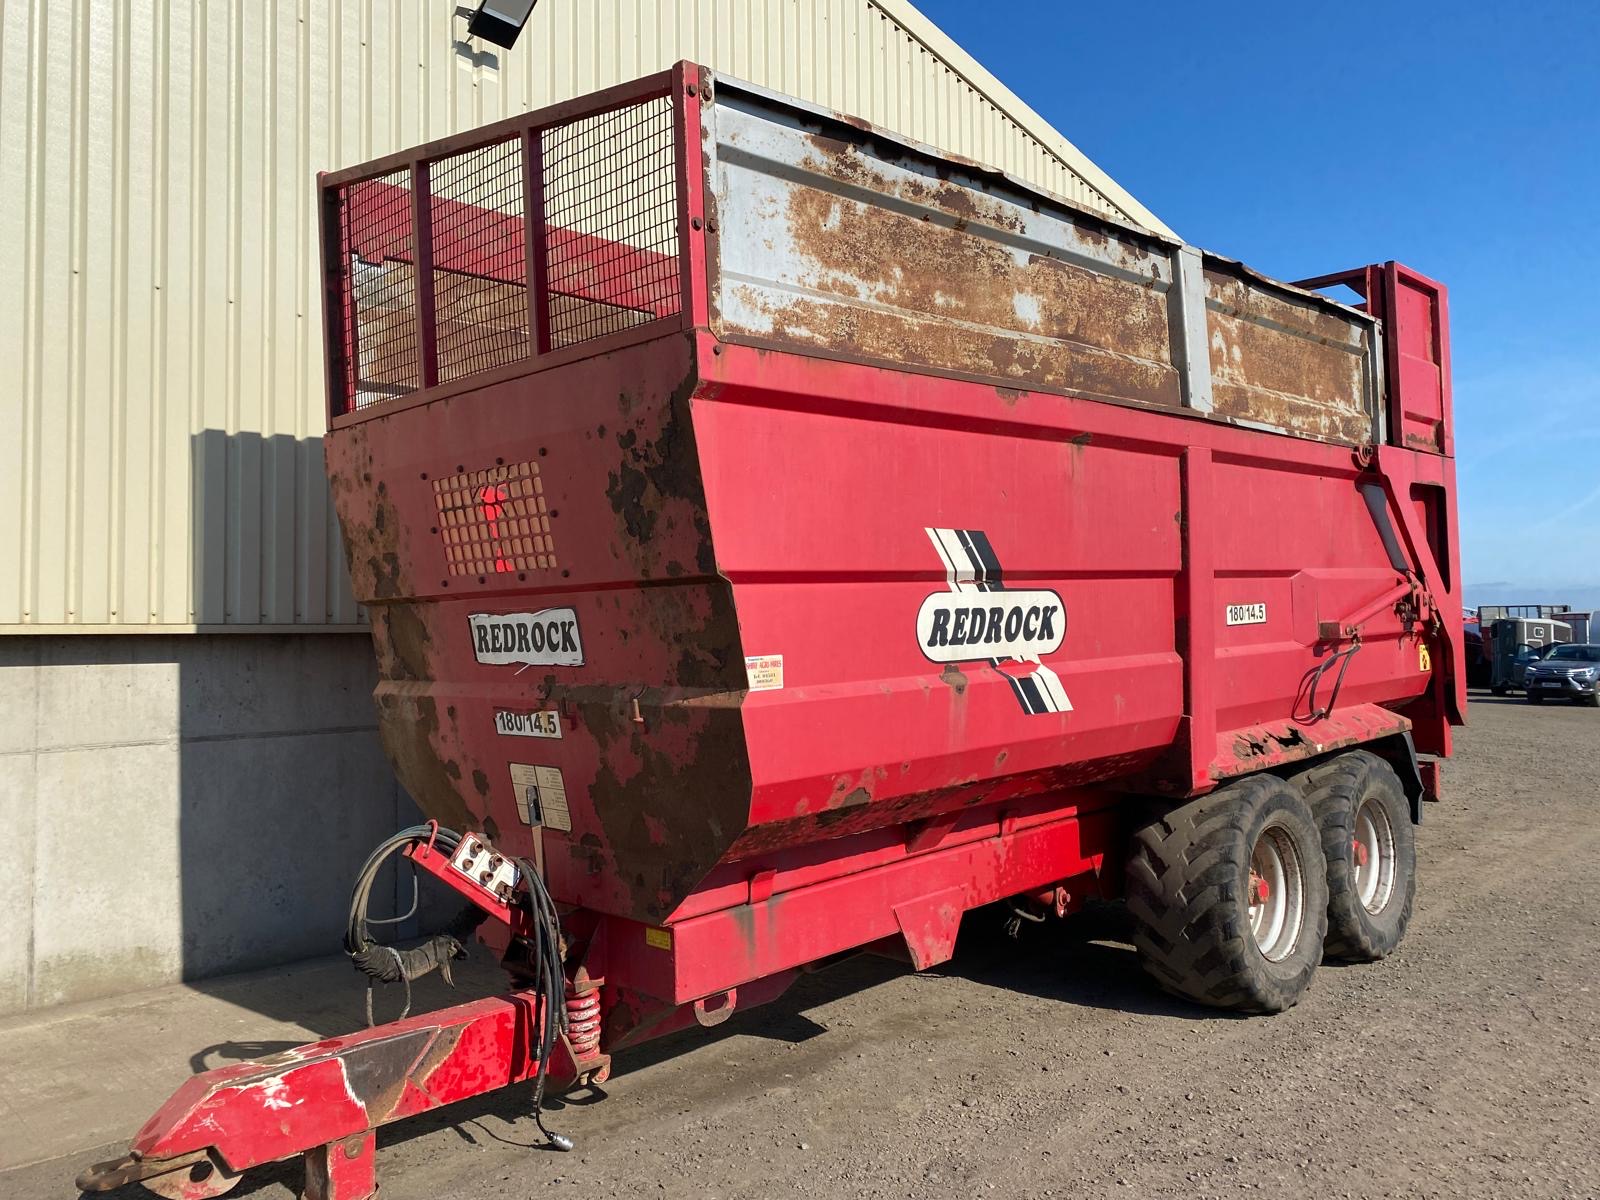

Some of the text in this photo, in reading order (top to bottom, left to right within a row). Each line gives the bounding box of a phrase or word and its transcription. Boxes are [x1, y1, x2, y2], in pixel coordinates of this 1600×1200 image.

[927, 605, 1058, 647] REDROCK
[1229, 605, 1264, 622] 180/14.5
[476, 620, 578, 654] REDROCK
[499, 711, 557, 735] 180/14.5
